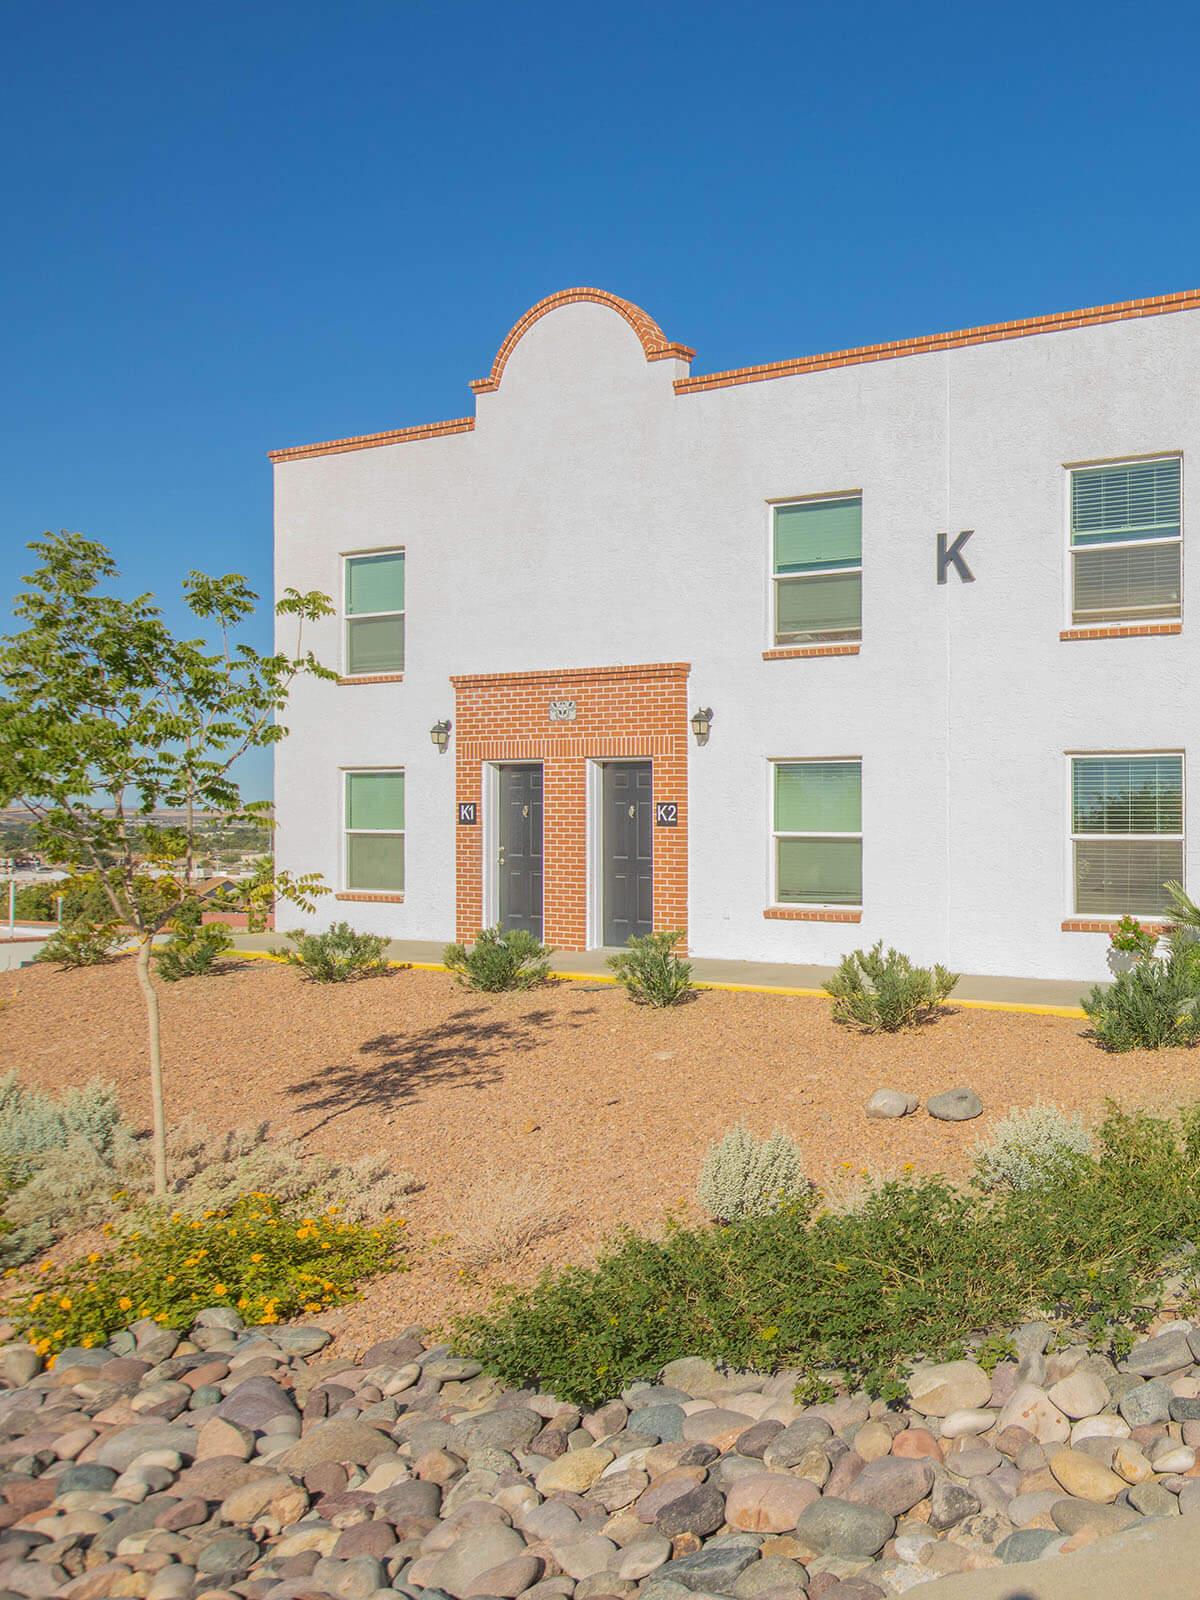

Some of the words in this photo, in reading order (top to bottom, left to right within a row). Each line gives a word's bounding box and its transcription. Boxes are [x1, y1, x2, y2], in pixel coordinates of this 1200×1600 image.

[936, 529, 976, 585] K
[460, 804, 475, 820] K1
[657, 804, 677, 821] K2
